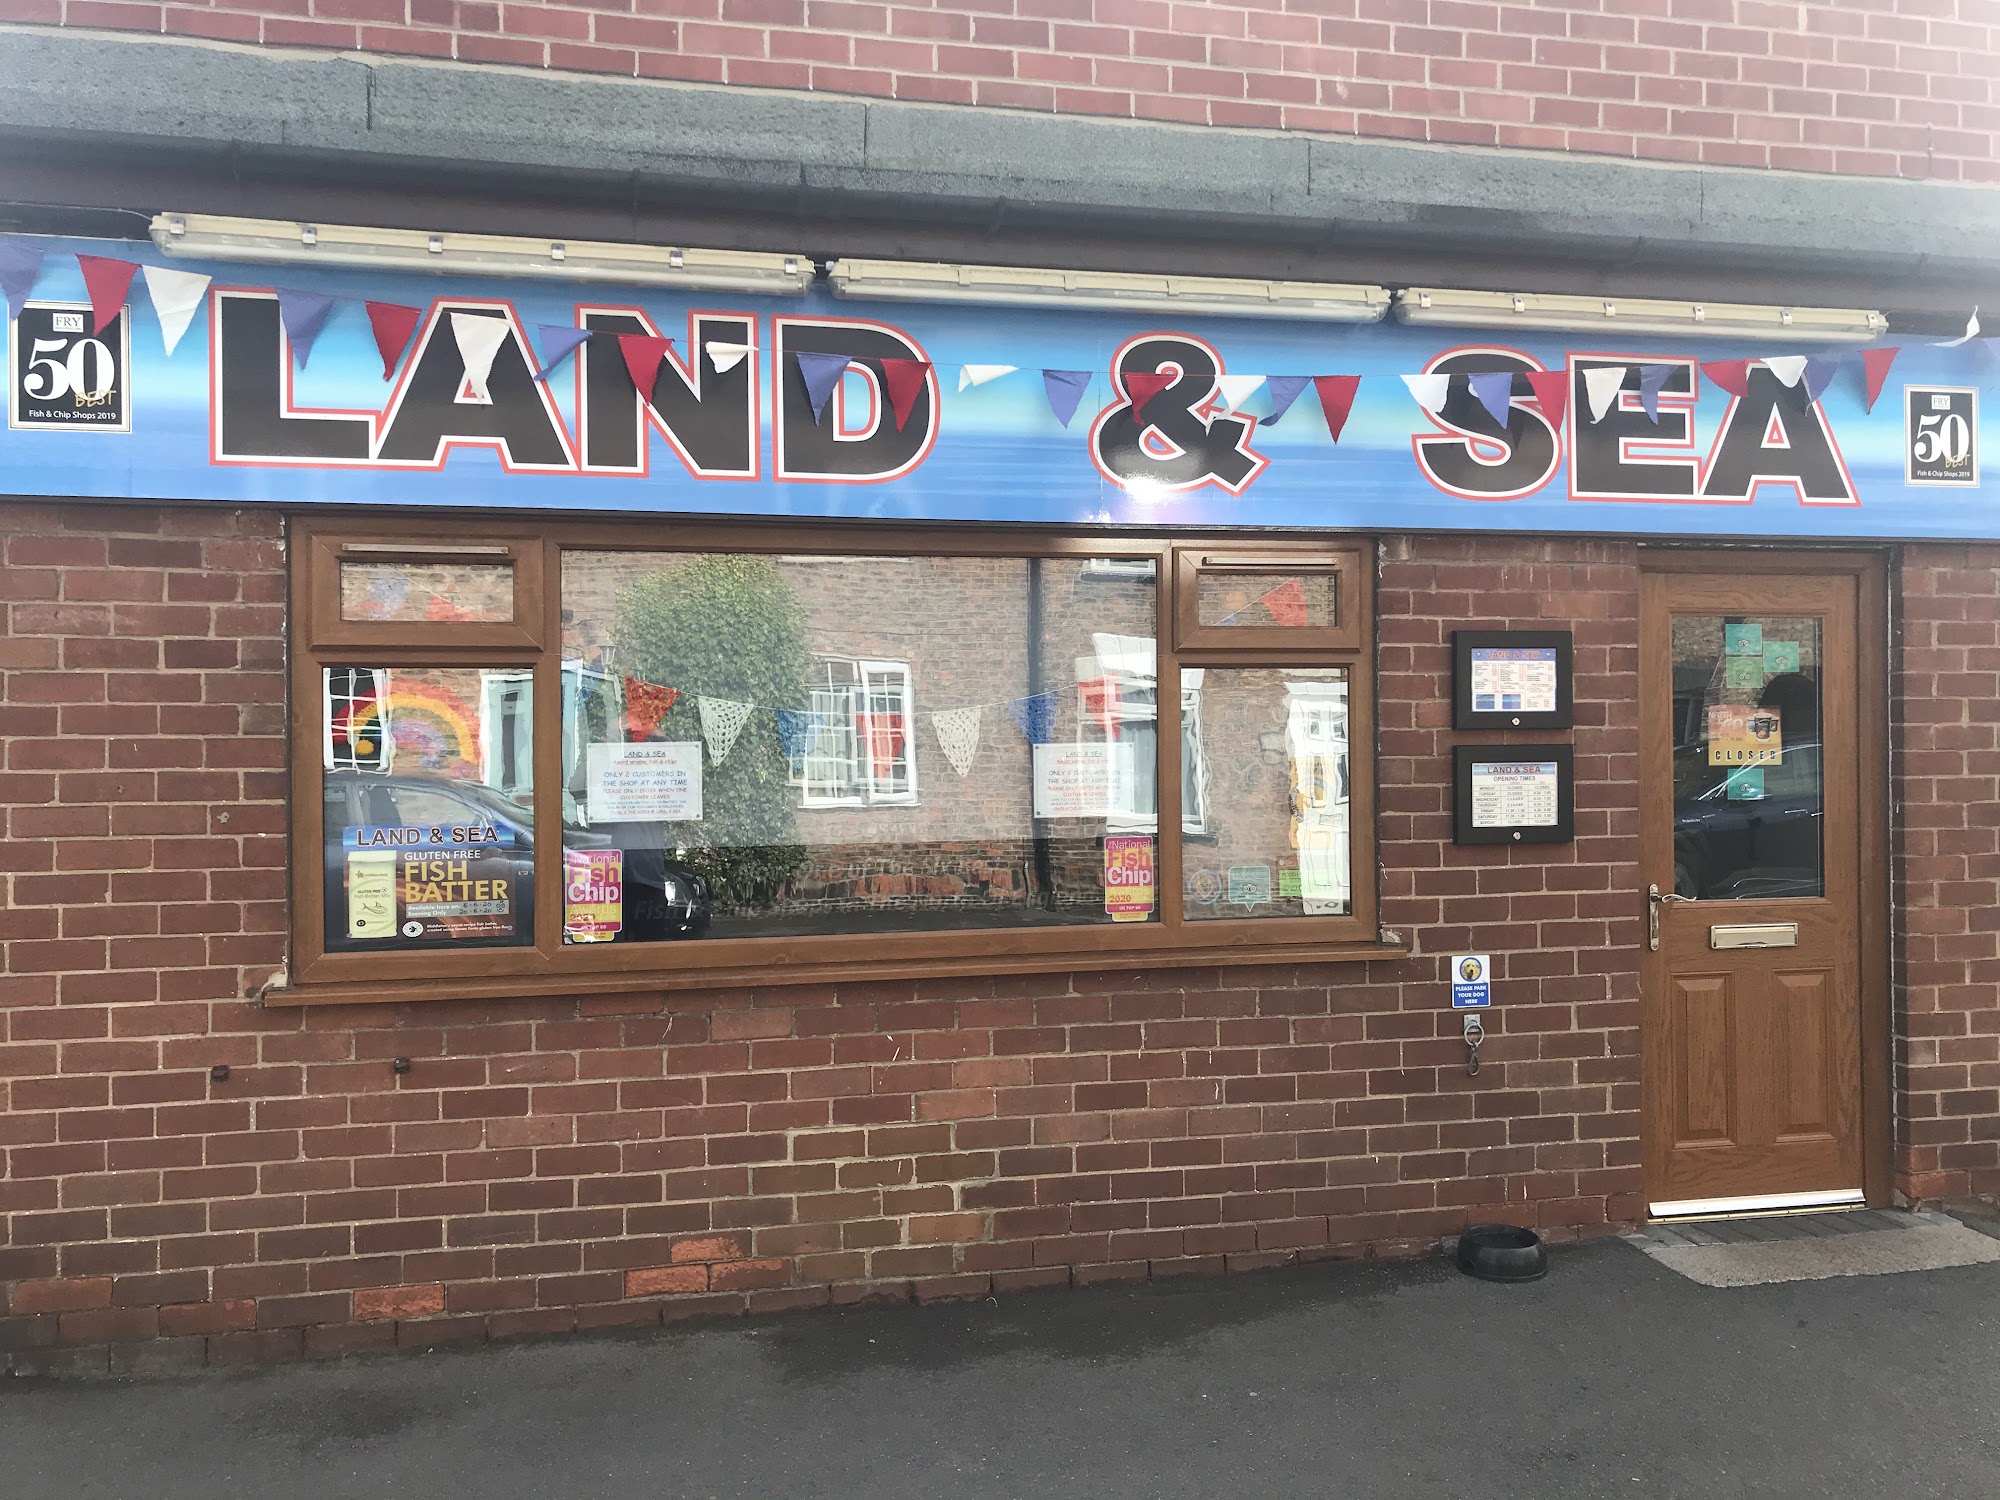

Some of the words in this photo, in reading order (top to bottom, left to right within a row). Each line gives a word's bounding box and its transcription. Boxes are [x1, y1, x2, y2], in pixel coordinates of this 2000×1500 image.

[56, 316, 81, 326] FRY
[24, 338, 114, 400] 50
[75, 390, 116, 407] BEST
[211, 288, 939, 482] LAND
[1088, 331, 1270, 495] &
[1412, 345, 1862, 507] SEA
[1933, 397, 1949, 406] FRY
[72, 412, 96, 420] Shops
[1914, 414, 1969, 462] 50
[1945, 454, 1970, 468] BEST
[1716, 750, 1776, 760] CLOSED
[357, 828, 421, 846] LAND
[428, 827, 444, 844] &
[452, 826, 499, 844] SEA
[1112, 840, 1150, 850] National
[404, 850, 450, 860] GLUTEN
[454, 850, 480, 858] FREE
[574, 854, 618, 864] National
[1108, 848, 1152, 866] Fish
[405, 860, 468, 882] FISH
[1108, 866, 1150, 886] Chip
[406, 880, 508, 902] BATTER
[568, 882, 618, 904] Chip
[571, 904, 616, 914] Awards
